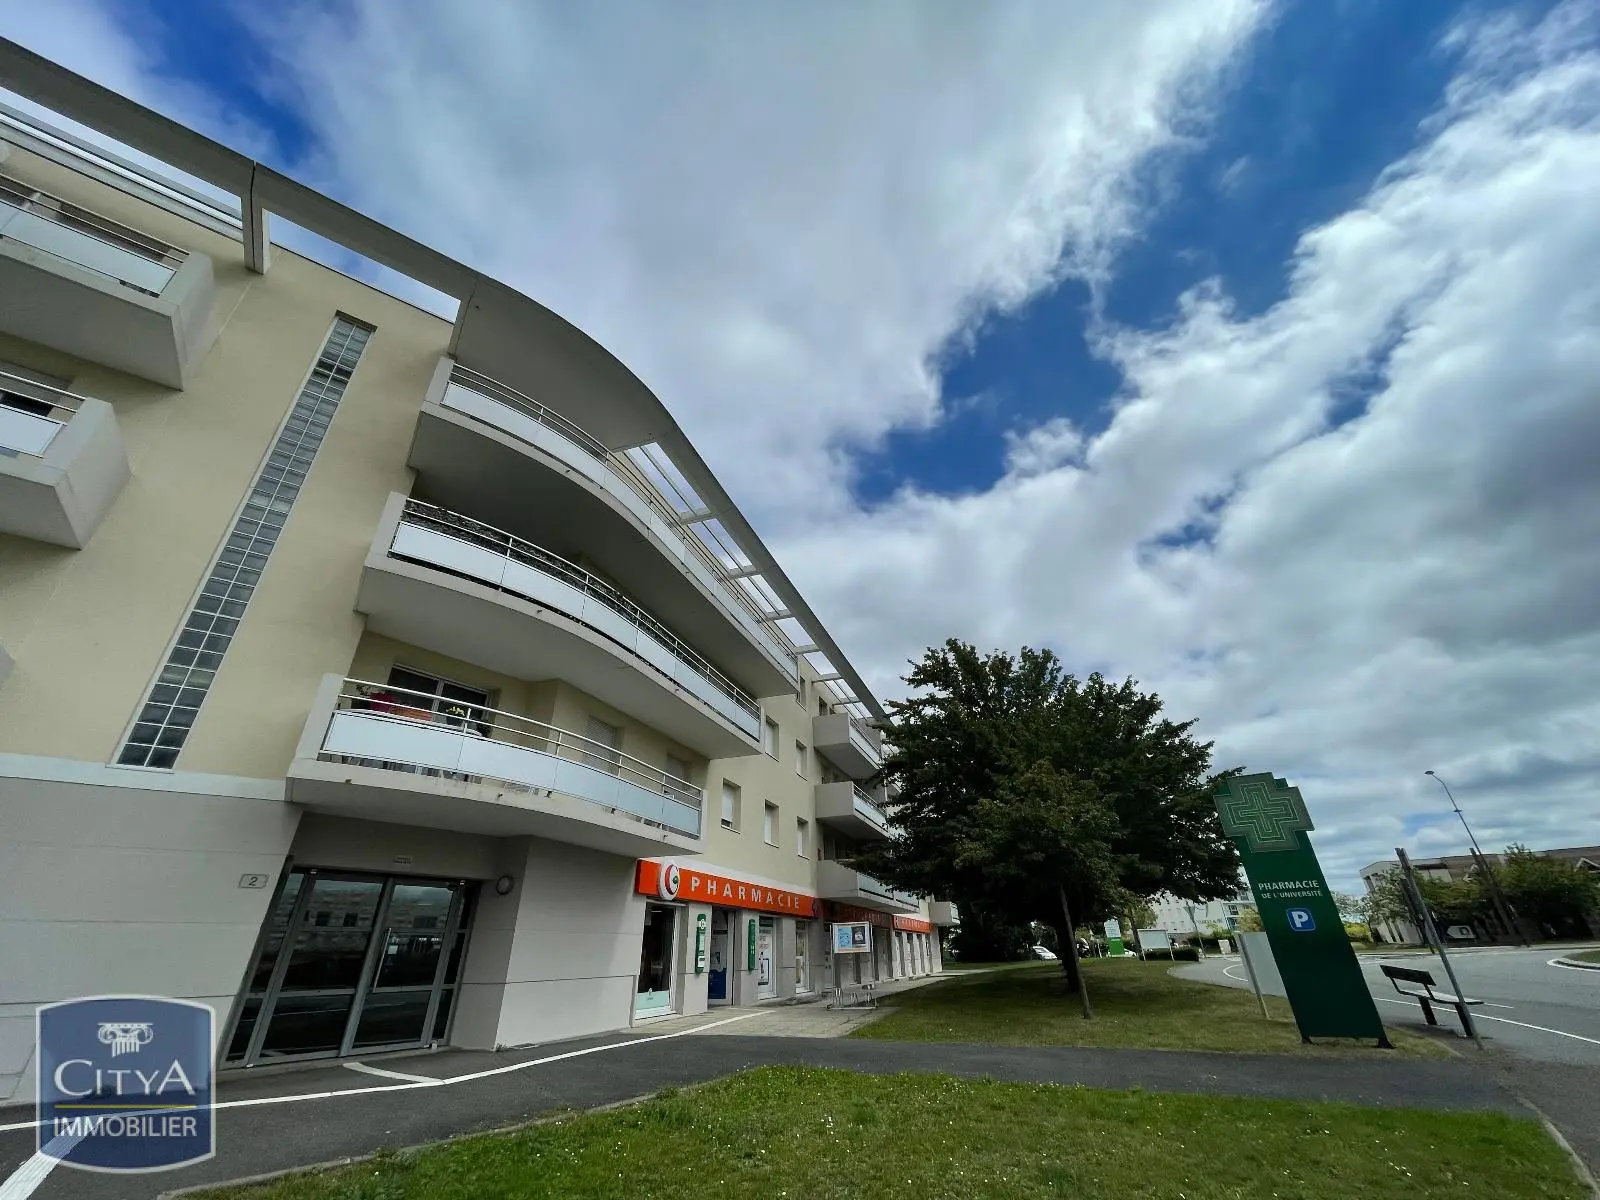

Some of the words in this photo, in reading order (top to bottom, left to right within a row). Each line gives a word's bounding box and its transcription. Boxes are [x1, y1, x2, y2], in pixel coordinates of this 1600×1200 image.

[249, 876, 258, 886] 2
[1258, 880, 1320, 890] PHARMACIE
[690, 876, 800, 909] PHARMACIE
[1291, 911, 1309, 928] P
